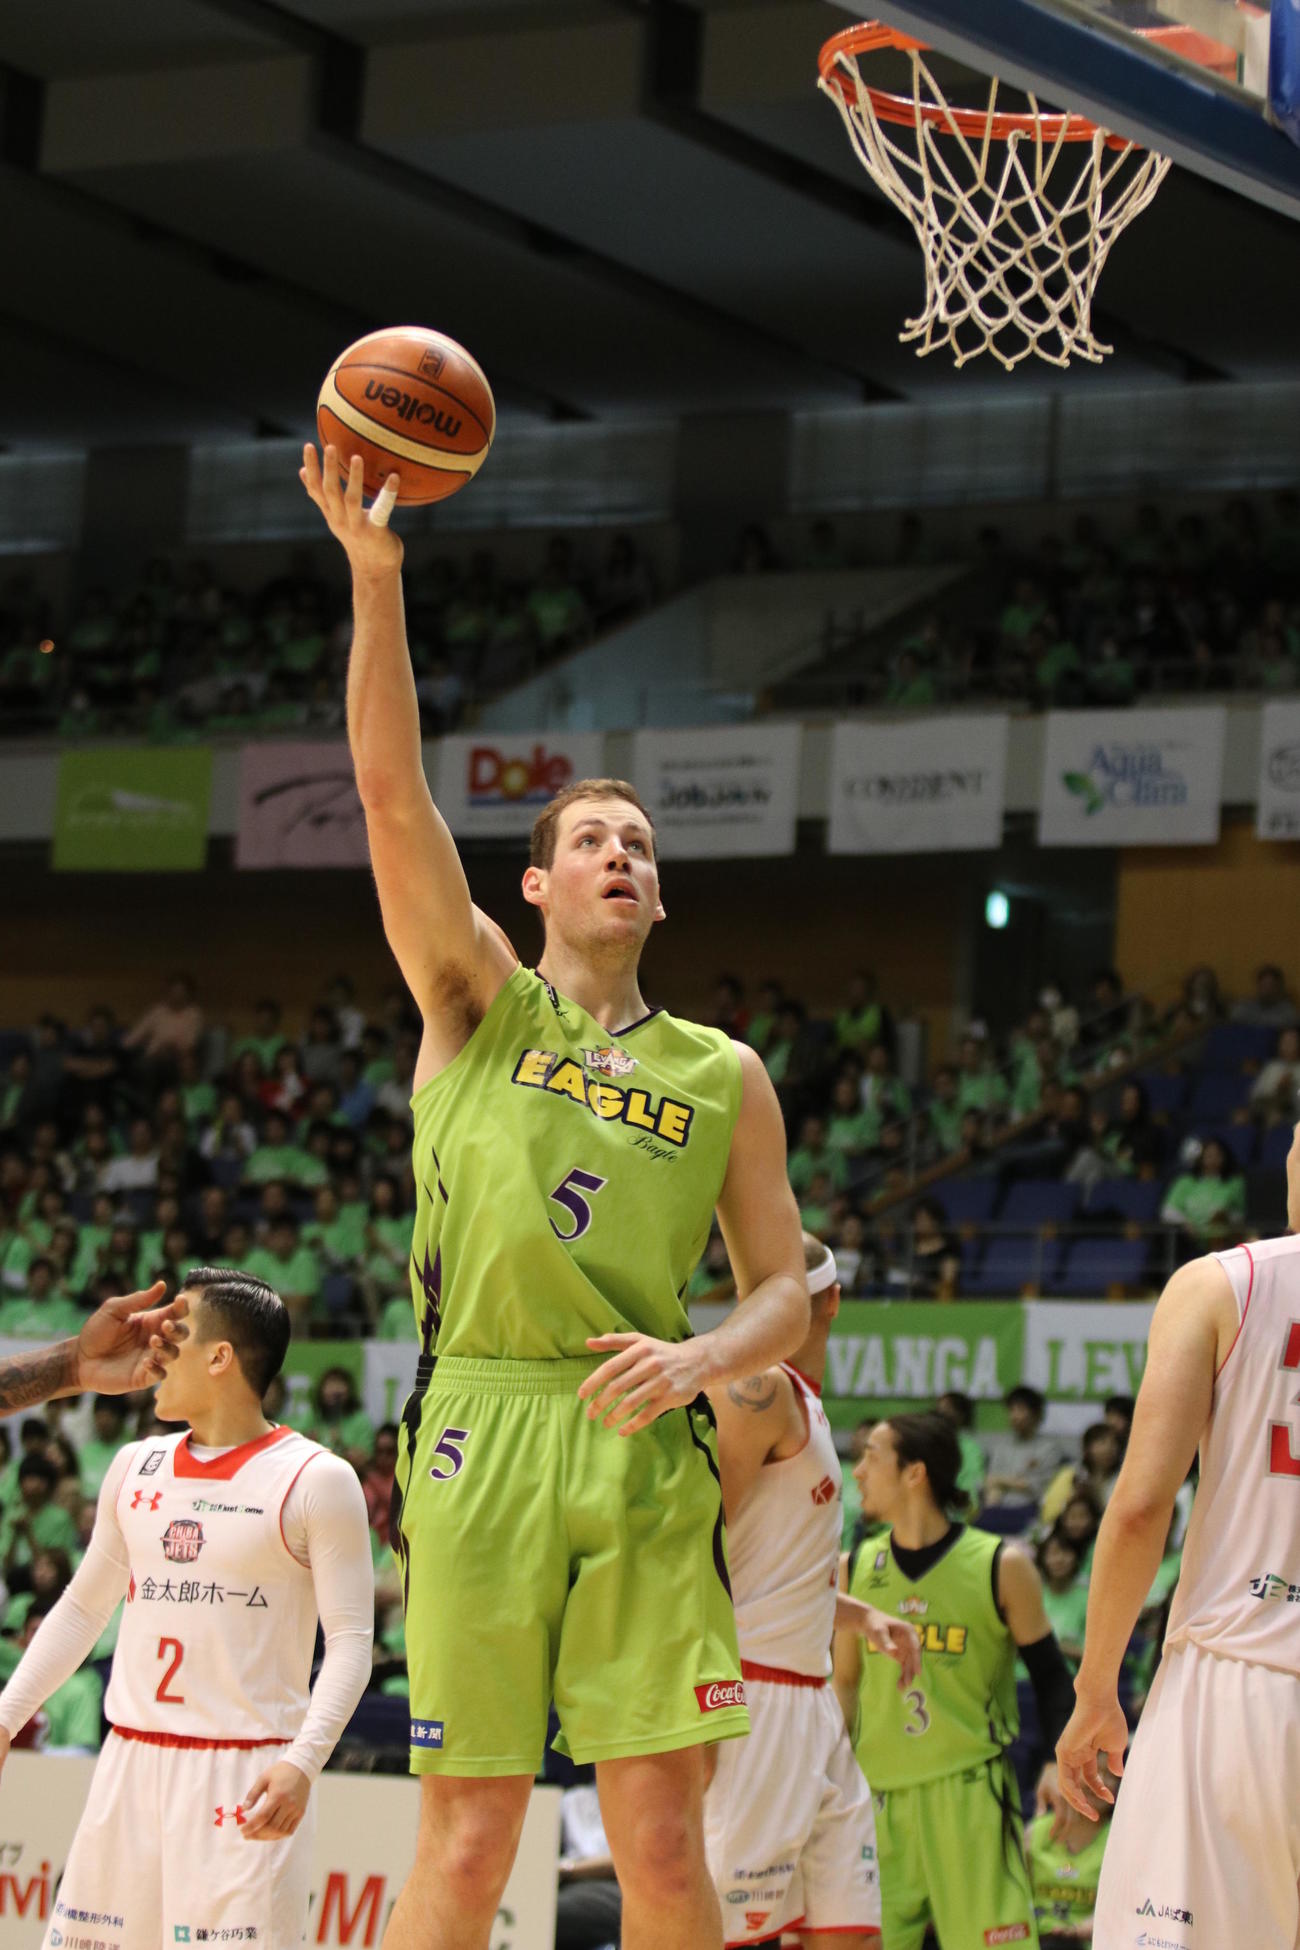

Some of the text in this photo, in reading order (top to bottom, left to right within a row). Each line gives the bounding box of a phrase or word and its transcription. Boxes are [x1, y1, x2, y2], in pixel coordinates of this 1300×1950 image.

[364, 379, 463, 438] molten
[466, 743, 573, 798] Dole
[511, 1049, 695, 1147] EAGLE
[626, 1134, 679, 1163] Bagle
[548, 1166, 609, 1242] 5
[428, 1427, 471, 1480] 5
[141, 1576, 268, 1608] 金太郎ホーム
[155, 1636, 185, 1705] 2
[904, 1688, 931, 1737] 3
